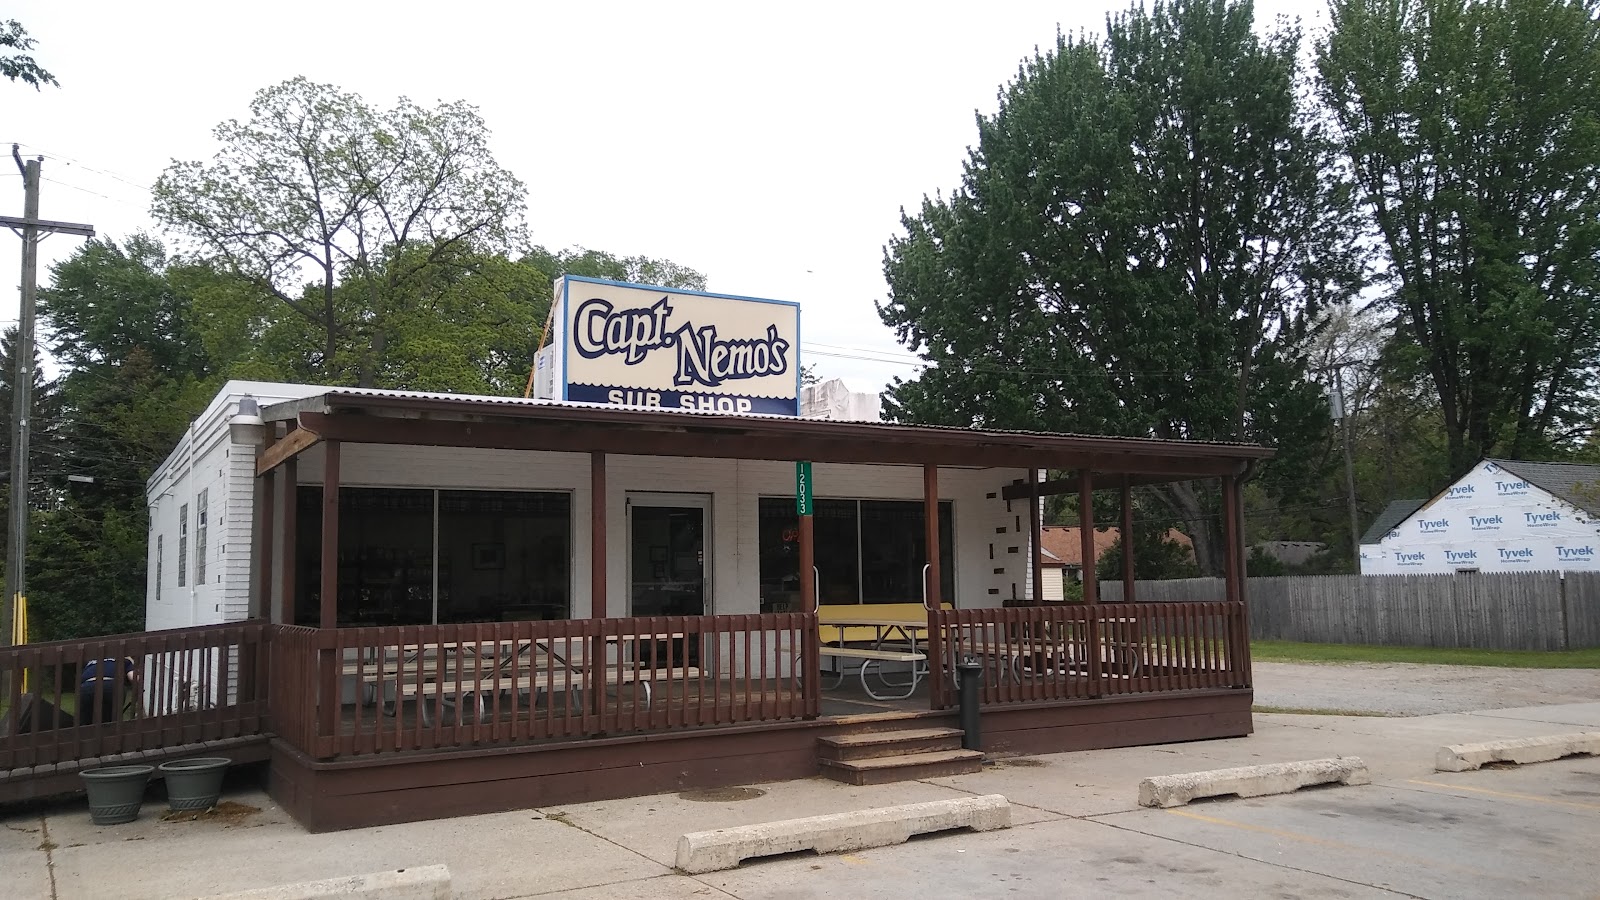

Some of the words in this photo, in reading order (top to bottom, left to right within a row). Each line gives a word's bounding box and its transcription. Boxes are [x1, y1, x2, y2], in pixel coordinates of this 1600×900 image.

[574, 295, 675, 365] Capt.
[674, 321, 790, 387] Nemo's
[607, 389, 661, 407] SUB
[680, 394, 752, 413] SHOP
[1449, 484, 1475, 496] yvek
[1494, 480, 1531, 493] Tyvek
[1468, 514, 1503, 527] Tyvek
[1523, 510, 1561, 524] Tyvek
[1417, 518, 1449, 530] Tyvek
[1394, 551, 1425, 563] Tyvek
[1444, 549, 1478, 561] Tyvek
[1497, 547, 1534, 560] Tyvek
[1555, 545, 1594, 558] Tyvek
